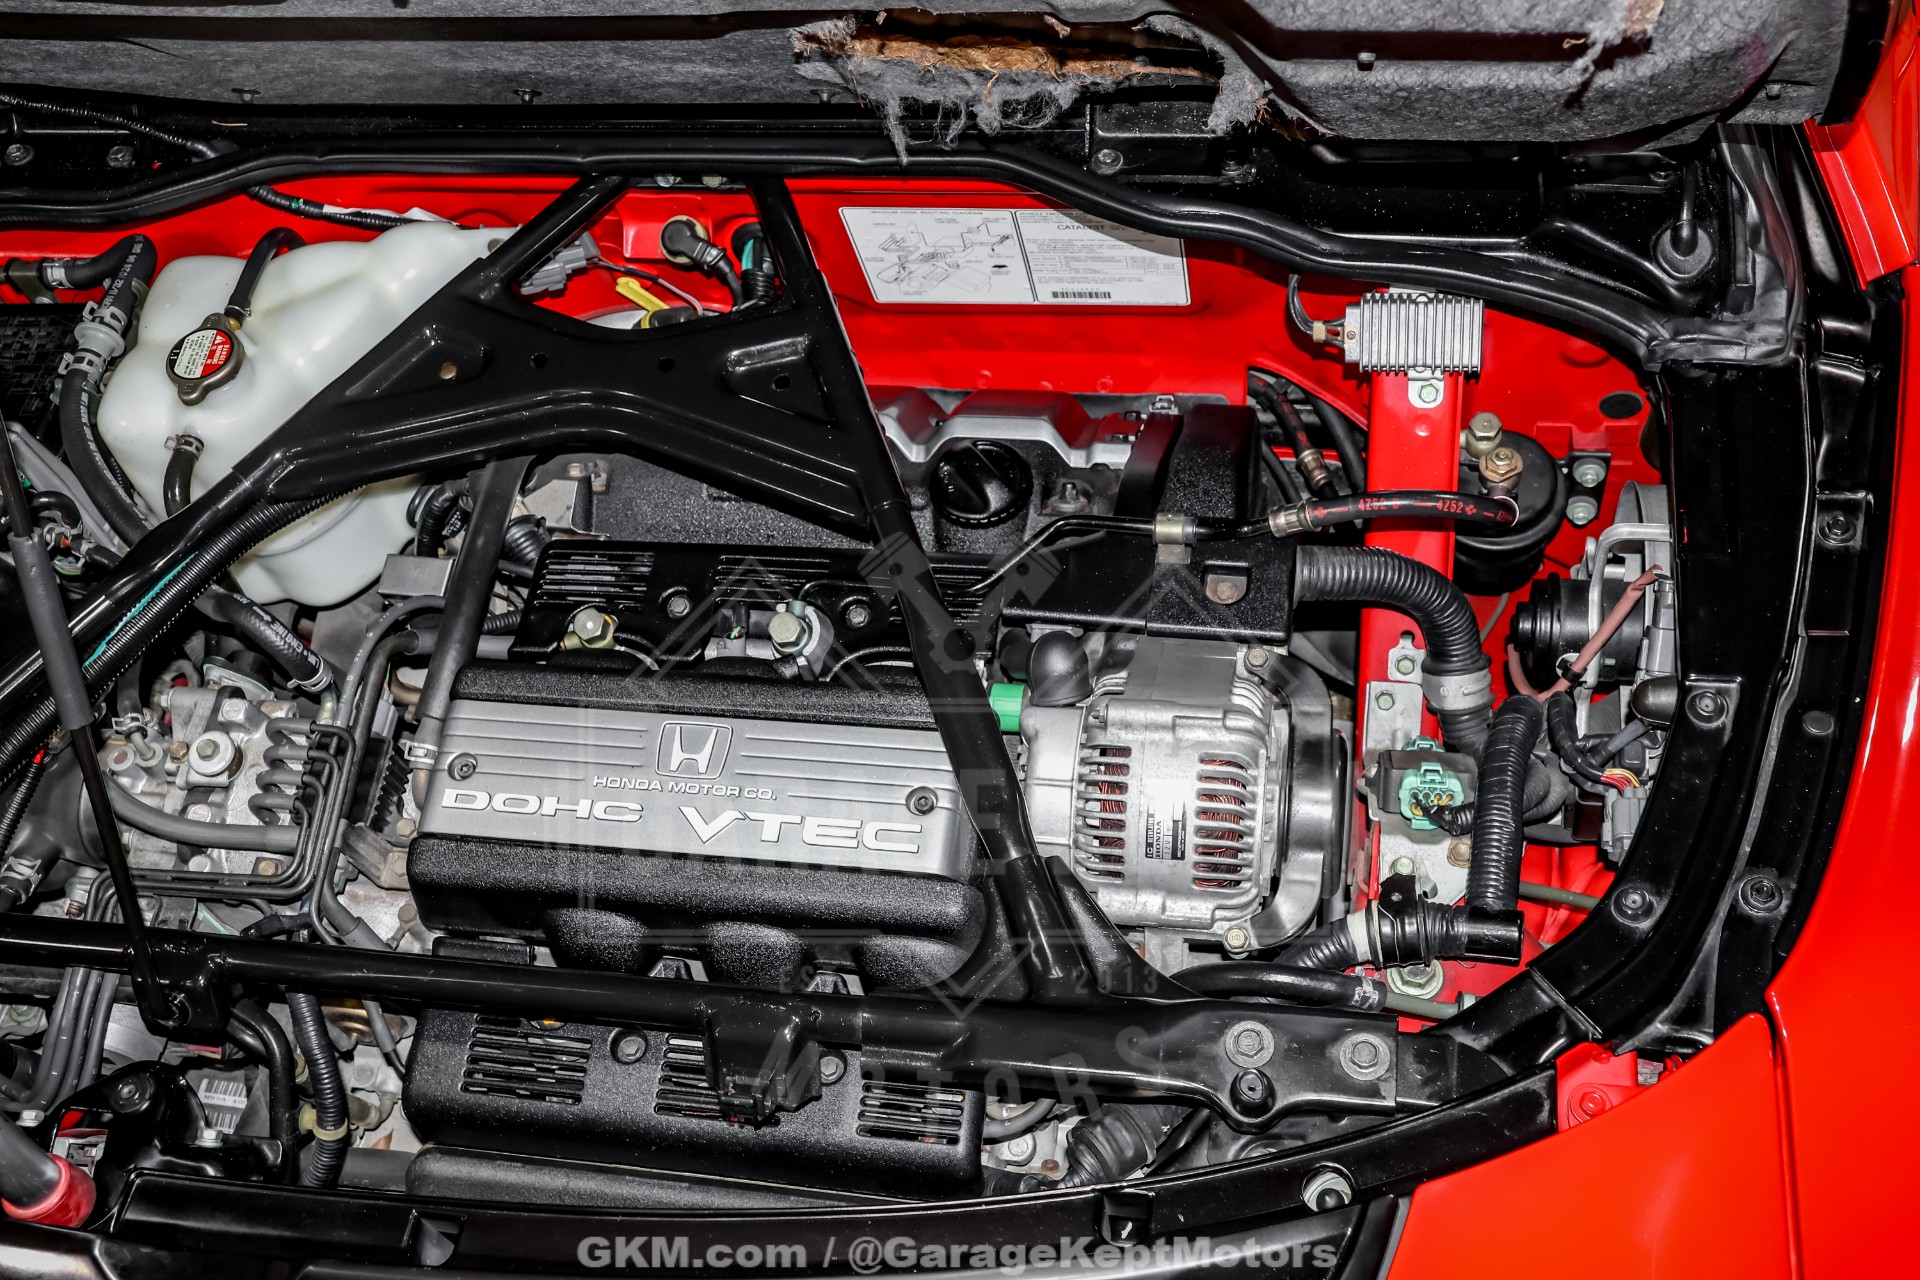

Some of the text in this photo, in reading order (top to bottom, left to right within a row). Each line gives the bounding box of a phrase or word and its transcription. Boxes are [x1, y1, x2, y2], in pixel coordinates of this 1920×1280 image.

[1436, 500, 1464, 513] 4Z52
[271, 620, 304, 652] ENGINE
[593, 775, 778, 800] HONDA MOTOR CO.
[440, 787, 924, 853] DOHC VTEC
